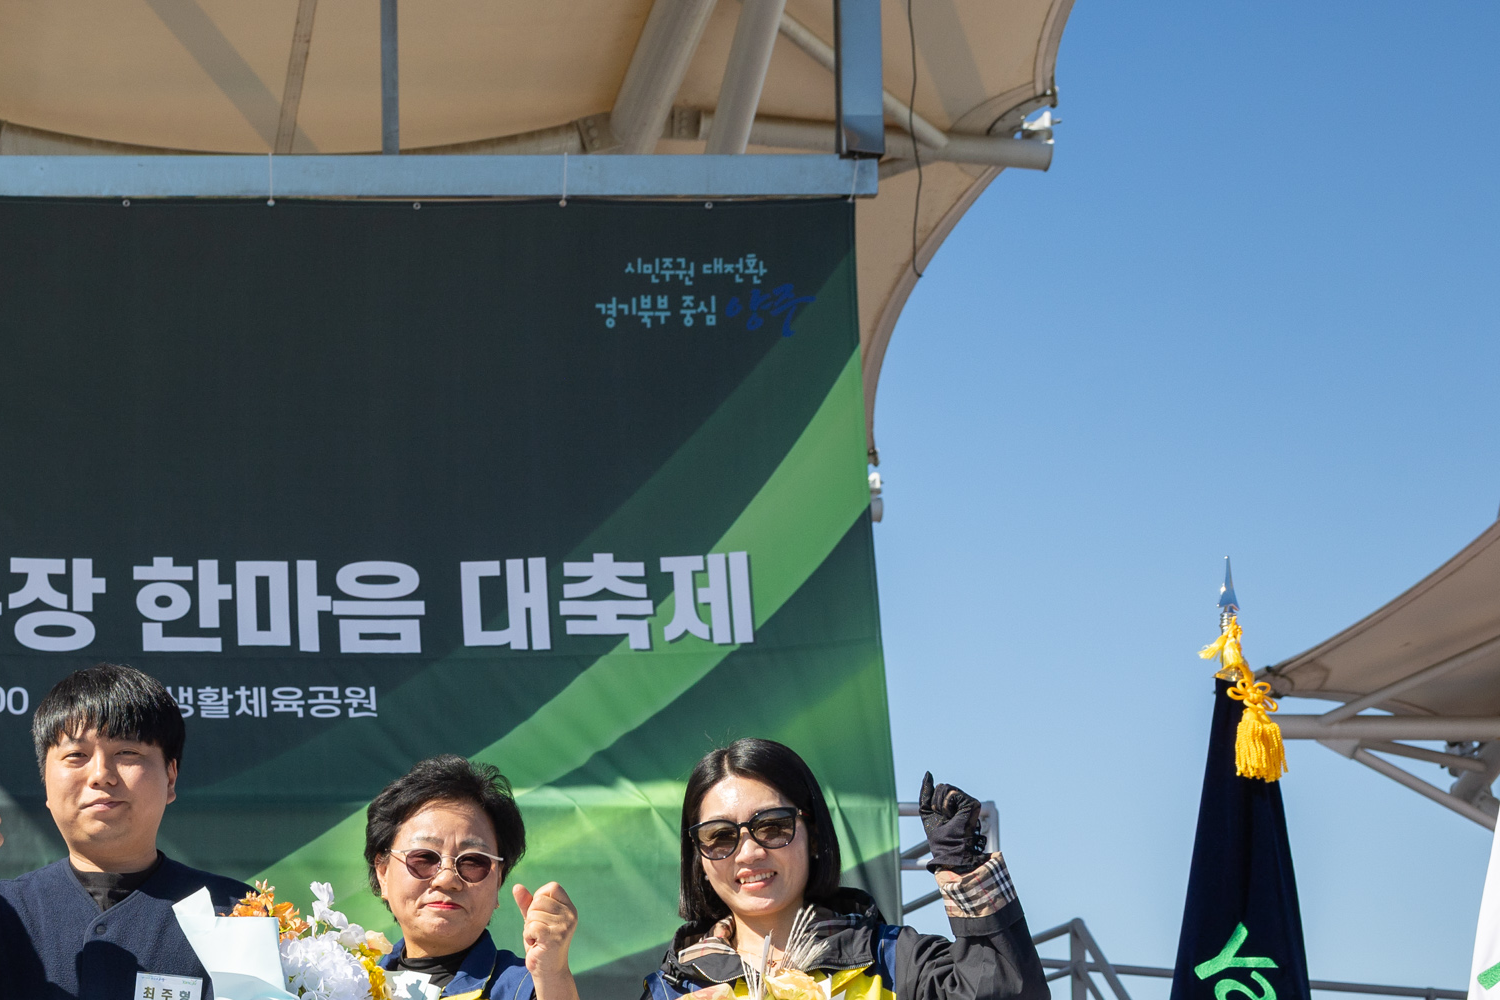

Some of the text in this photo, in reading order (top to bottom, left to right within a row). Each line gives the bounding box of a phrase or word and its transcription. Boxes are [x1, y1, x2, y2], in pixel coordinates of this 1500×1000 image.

[625, 254, 768, 286] 시민주권 대전환
[595, 283, 817, 338] 경기북부 중심 양주
[133, 556, 425, 654] 한마음
[460, 551, 754, 651] 대축제
